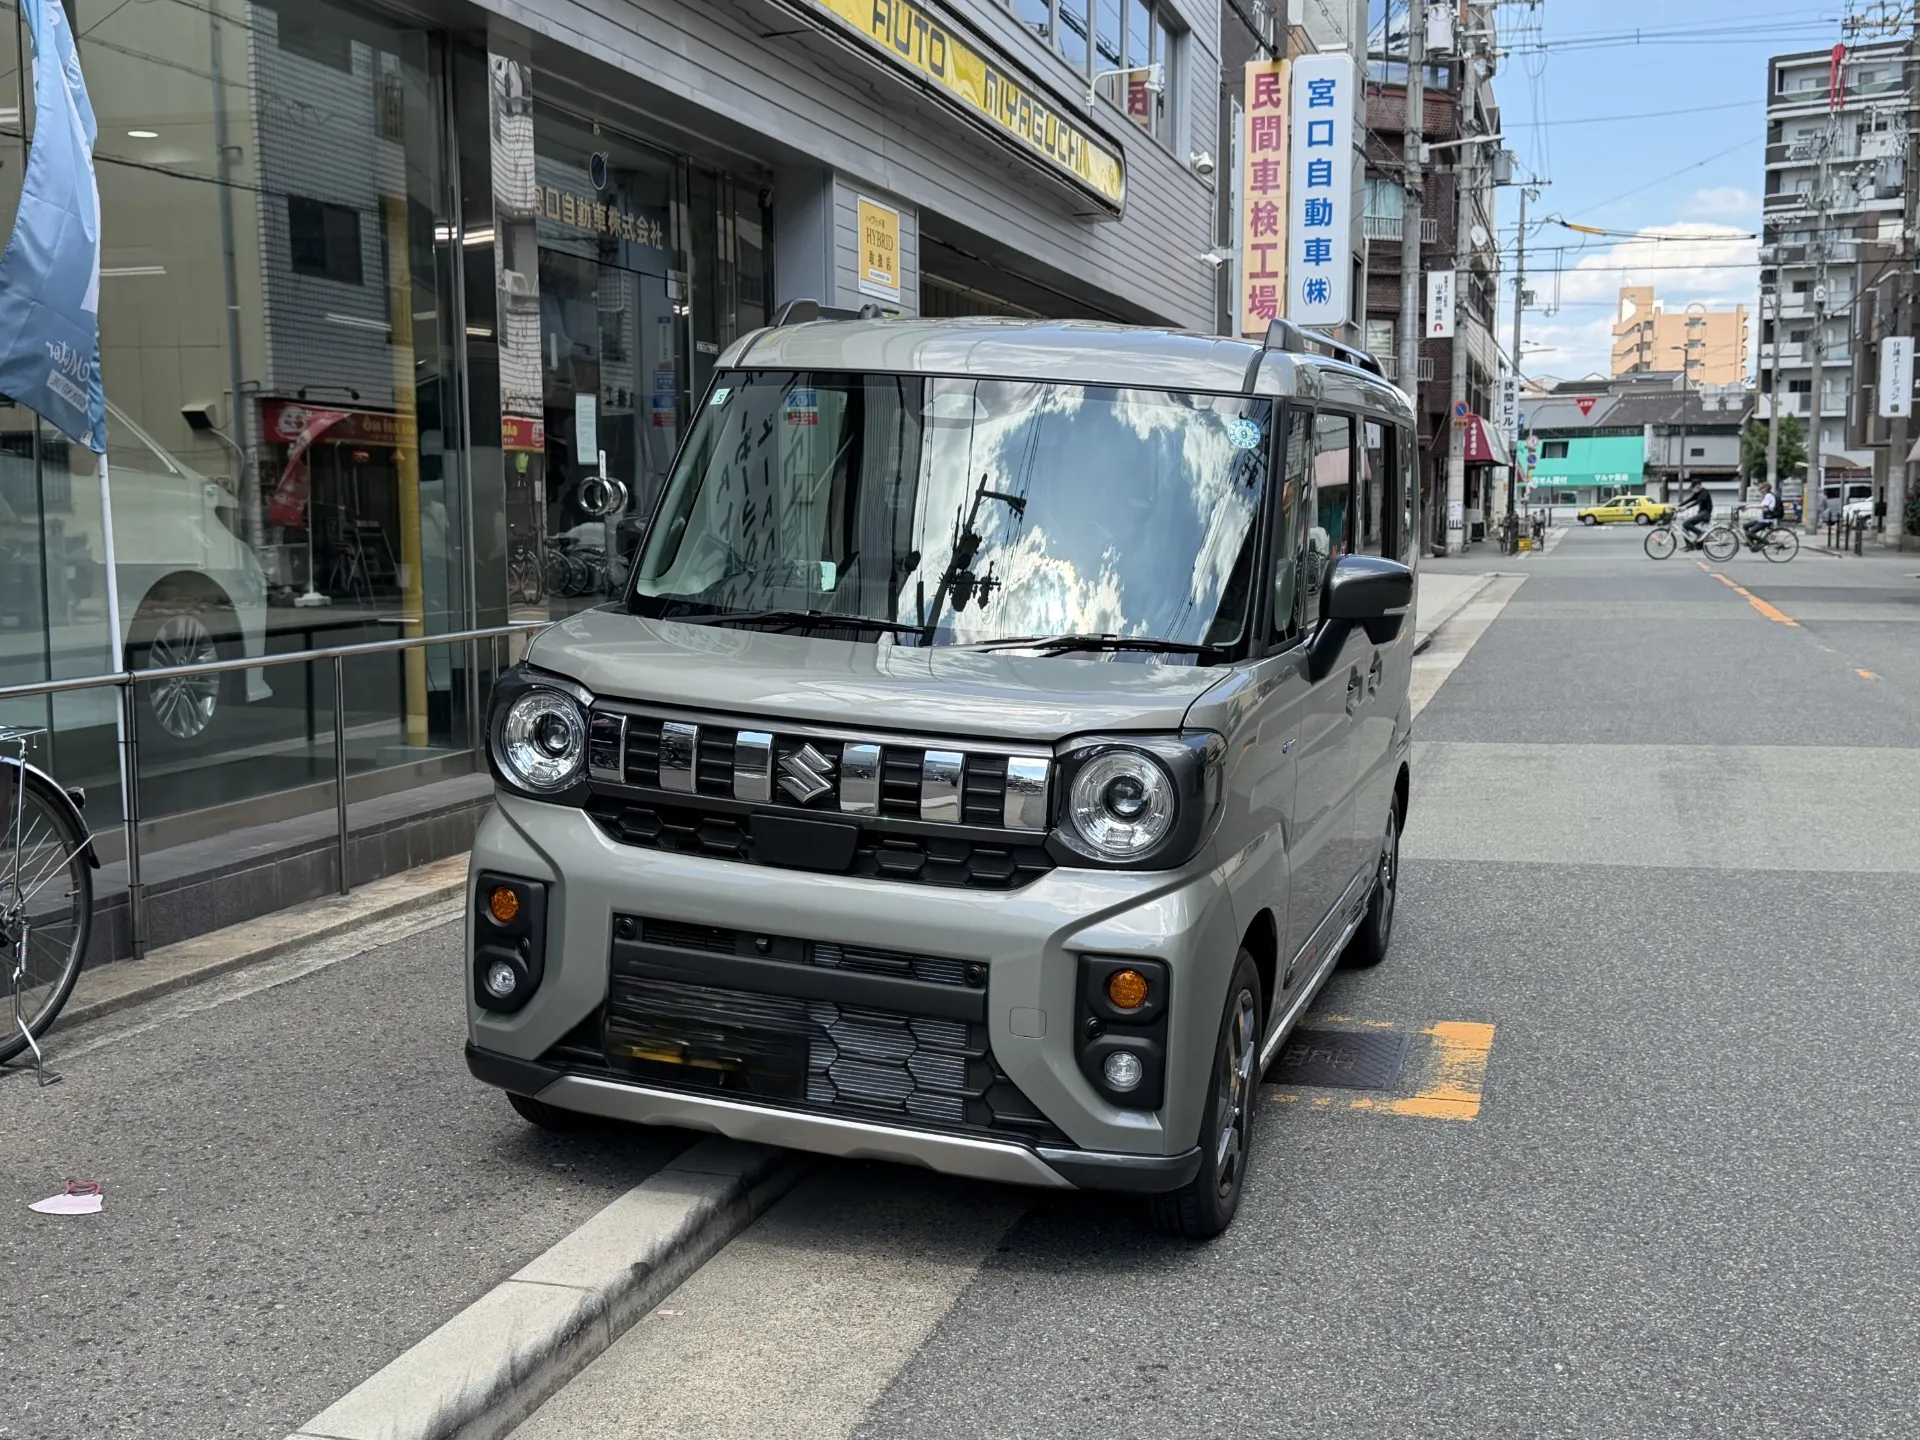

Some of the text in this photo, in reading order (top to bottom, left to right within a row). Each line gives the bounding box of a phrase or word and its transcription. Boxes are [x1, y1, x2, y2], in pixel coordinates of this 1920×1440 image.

[872, 0, 945, 78] AUTO
[1248, 72, 1282, 321] 民間車検工場
[866, 227, 893, 251] HYBRID
[716, 394, 724, 403] 5
